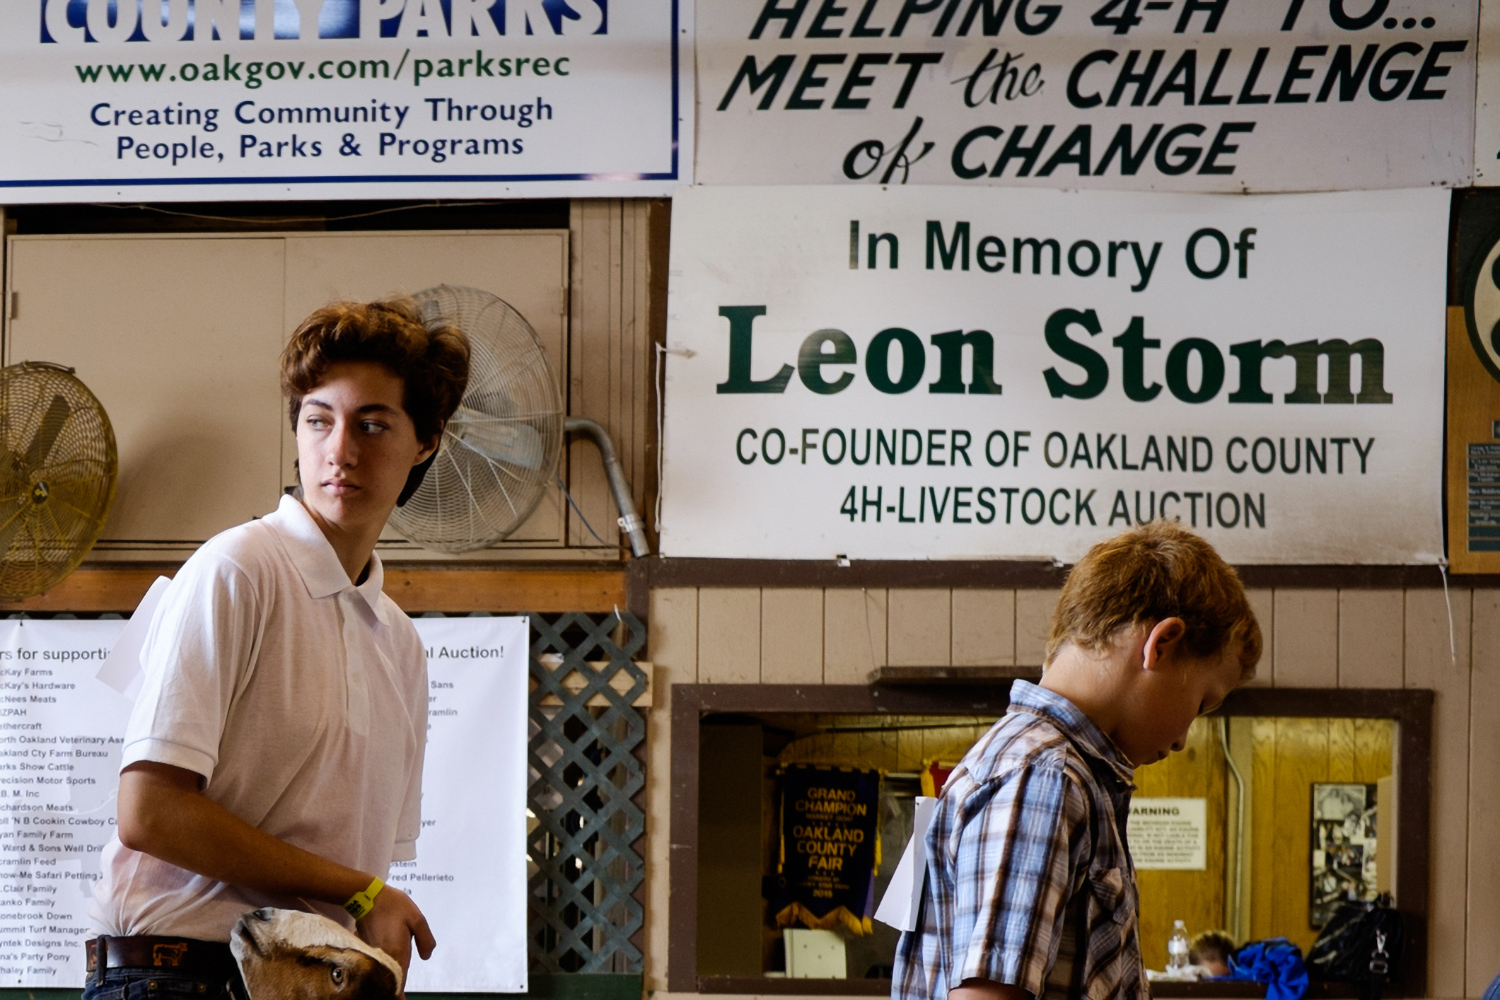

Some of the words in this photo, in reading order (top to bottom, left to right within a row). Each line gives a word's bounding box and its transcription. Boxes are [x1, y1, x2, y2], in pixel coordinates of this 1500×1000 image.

[747, 0, 1076, 40] HELPING
[75, 49, 571, 88] www.oakgov.com/parksrec
[716, 52, 944, 111] MEET
[950, 48, 1046, 108] the
[1066, 40, 1469, 109] CHALLENGE
[89, 101, 220, 132] Creating
[233, 99, 411, 130] Community
[423, 97, 555, 126] Through
[116, 135, 226, 166] People,
[238, 132, 323, 158] Parks
[339, 134, 363, 158] &
[378, 131, 525, 163] Programs
[841, 116, 935, 185] of
[951, 121, 1258, 179] CHANGE
[849, 219, 901, 270] In
[925, 220, 1163, 292] Memory
[1184, 226, 1258, 280] Of
[716, 304, 1003, 396] Leon
[1042, 307, 1394, 404] Storm
[736, 428, 972, 468] CO-FOUNDER
[984, 430, 1031, 469] OF
[1043, 433, 1215, 473] OAKLAND
[1225, 437, 1375, 475] COUNTY
[840, 485, 1097, 527] 4H-LIVESTOCK
[1108, 490, 1268, 530] AUCTION
[17, 648, 38, 660] for
[43, 648, 110, 663] supporti
[439, 646, 504, 659] Auction!
[66, 777, 96, 786] Sports
[807, 787, 856, 801] GRAND
[795, 800, 867, 816] CHAMPION
[1129, 807, 1180, 816] ARNING
[17, 831, 47, 840] Family
[793, 825, 864, 843] OAKLAND
[797, 841, 857, 856] COUNTY
[808, 855, 843, 871] FAIR
